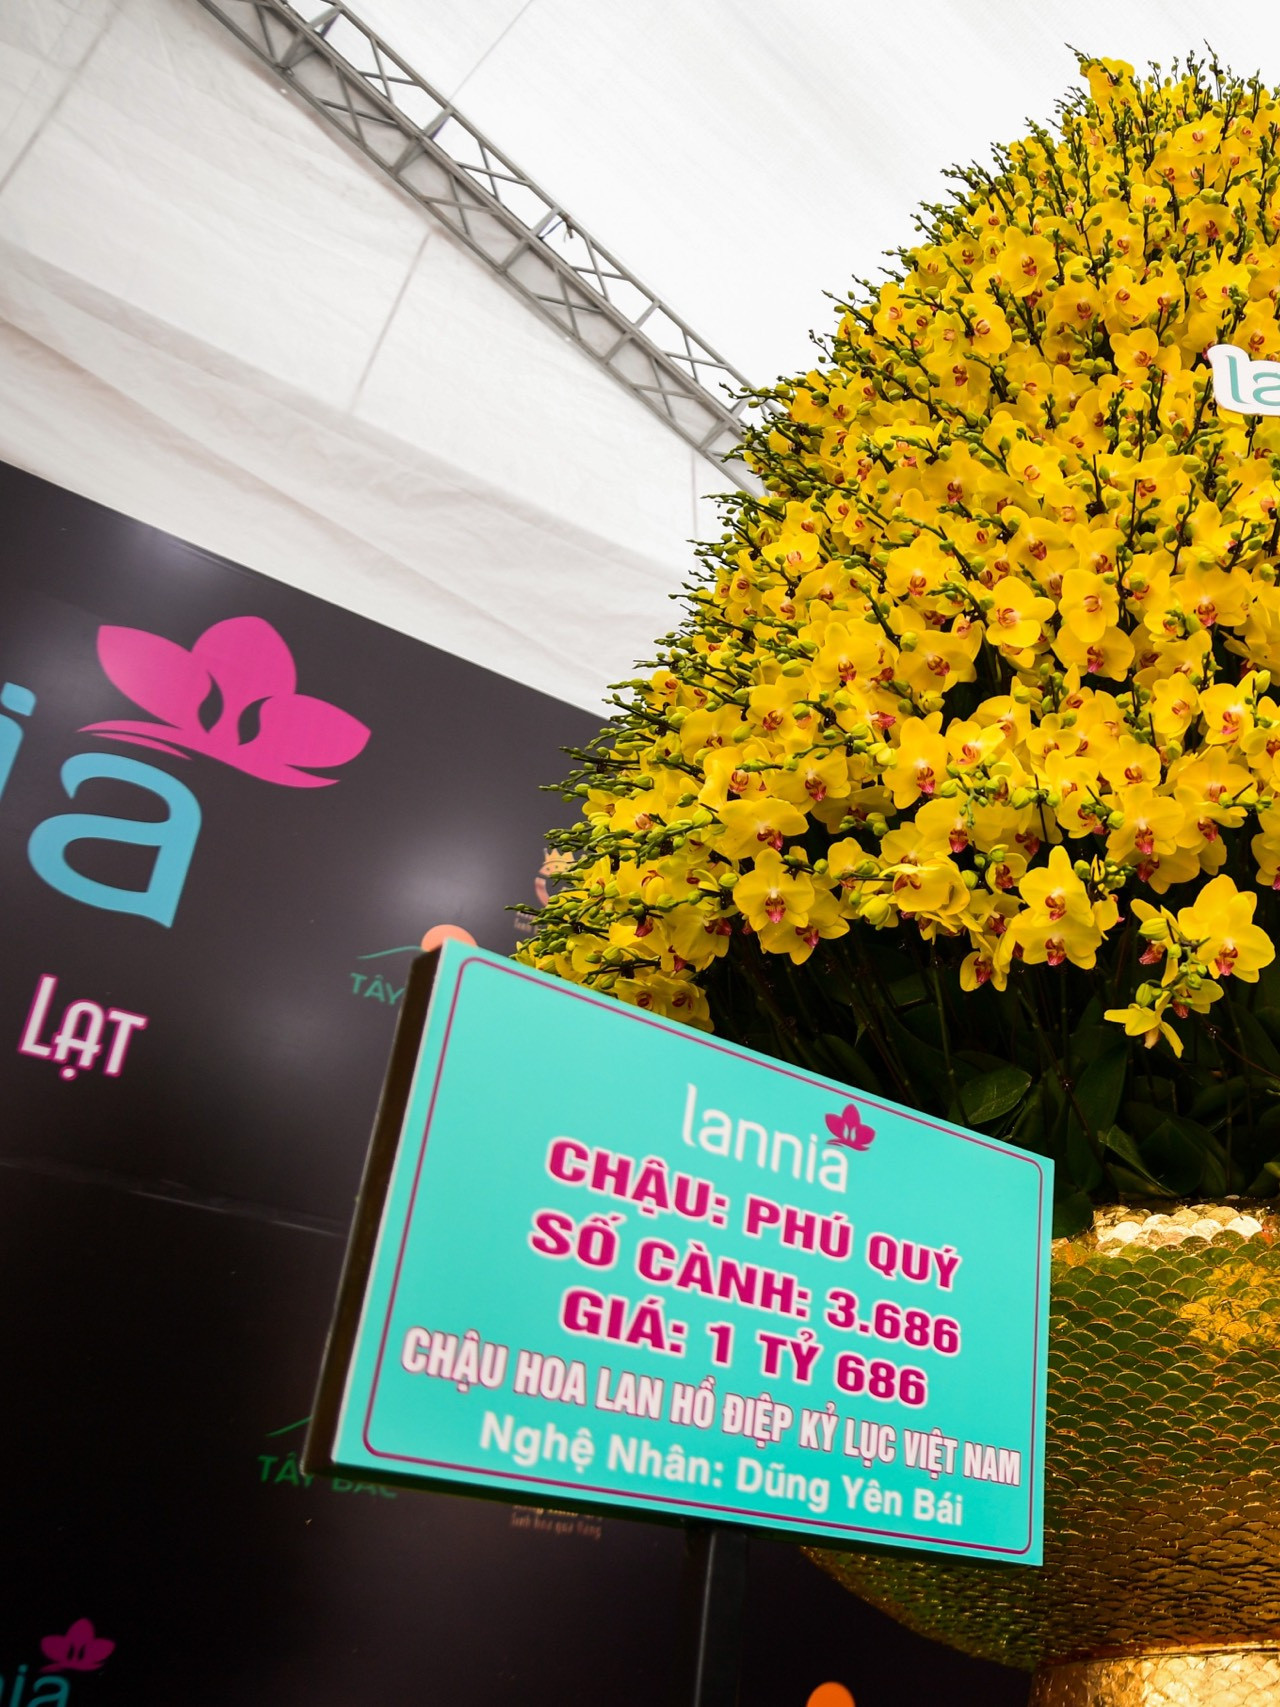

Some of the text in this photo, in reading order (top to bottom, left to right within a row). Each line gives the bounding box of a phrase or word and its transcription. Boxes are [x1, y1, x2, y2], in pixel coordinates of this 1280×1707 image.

[17, 973, 149, 1081] LẠT
[351, 972, 405, 1005] TÂY
[683, 1082, 849, 1194] lannia
[546, 1137, 961, 1291] CHẬU: PHÚ QUÝ
[528, 1209, 961, 1355] SỐ CÀNH: 3.686
[561, 1286, 927, 1407] GIÁ: 1 TỶ 686
[401, 1327, 1021, 1486] CHẬU HOA LAN HỒ ĐIỆP KỶ LỤC VIỆT NAM
[479, 1410, 963, 1526] Nghệ Nhân: Dũng Yên Bái
